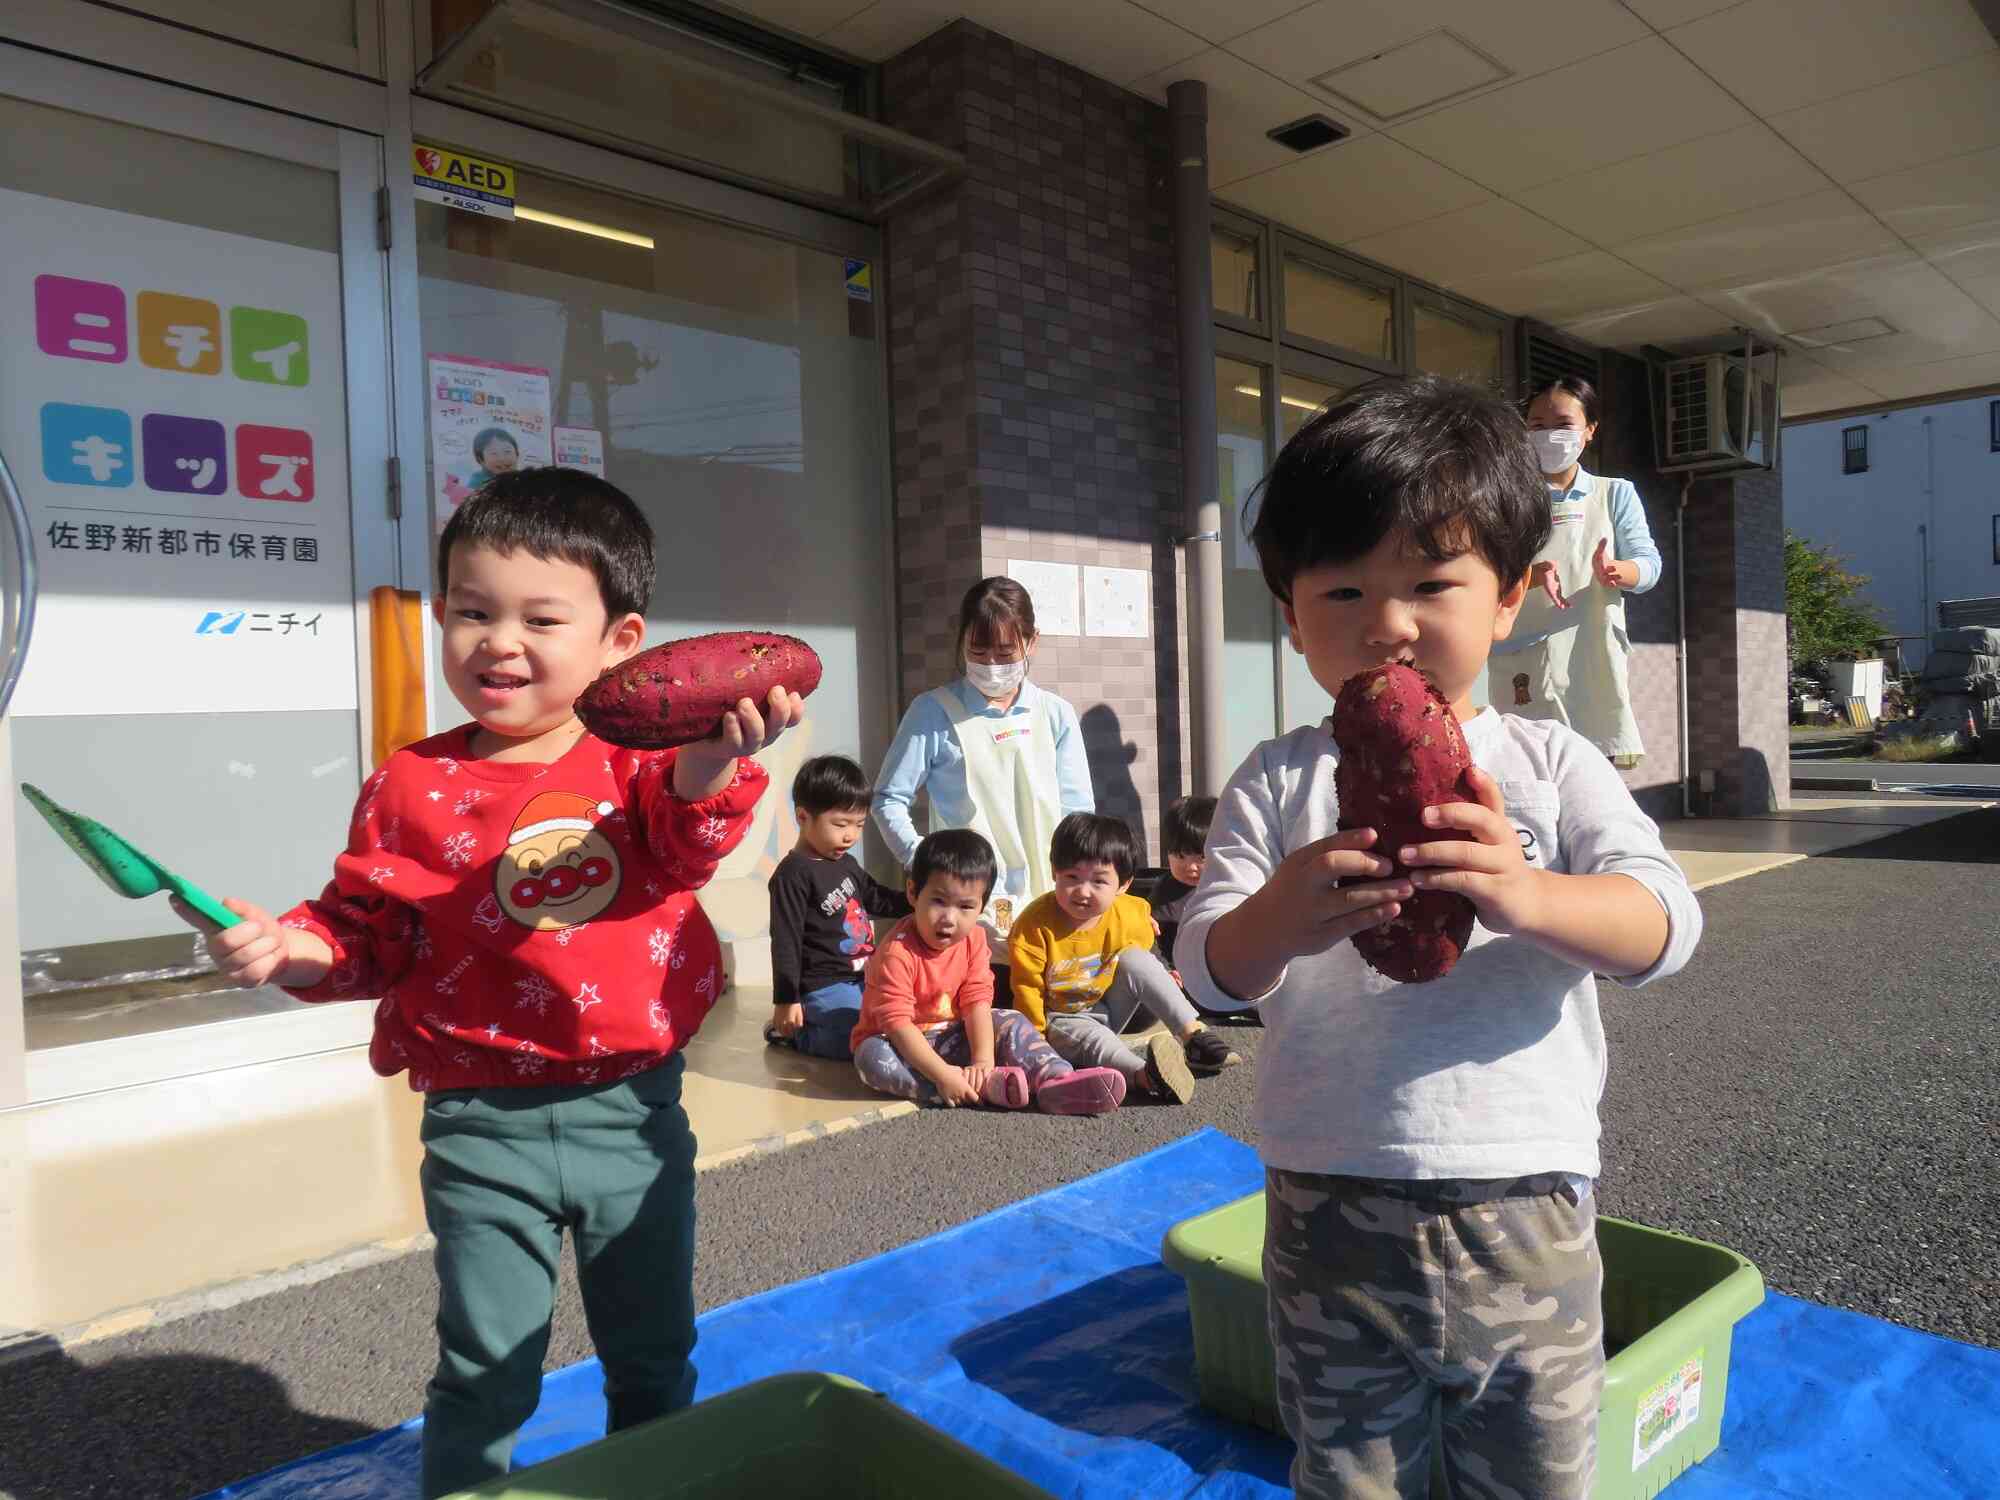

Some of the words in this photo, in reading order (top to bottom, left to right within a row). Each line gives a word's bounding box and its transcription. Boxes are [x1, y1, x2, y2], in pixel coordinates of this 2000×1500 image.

[446, 159, 506, 190] AED
[46, 520, 319, 563] 佐野新都市保育園
[249, 611, 323, 636] ニチイ
